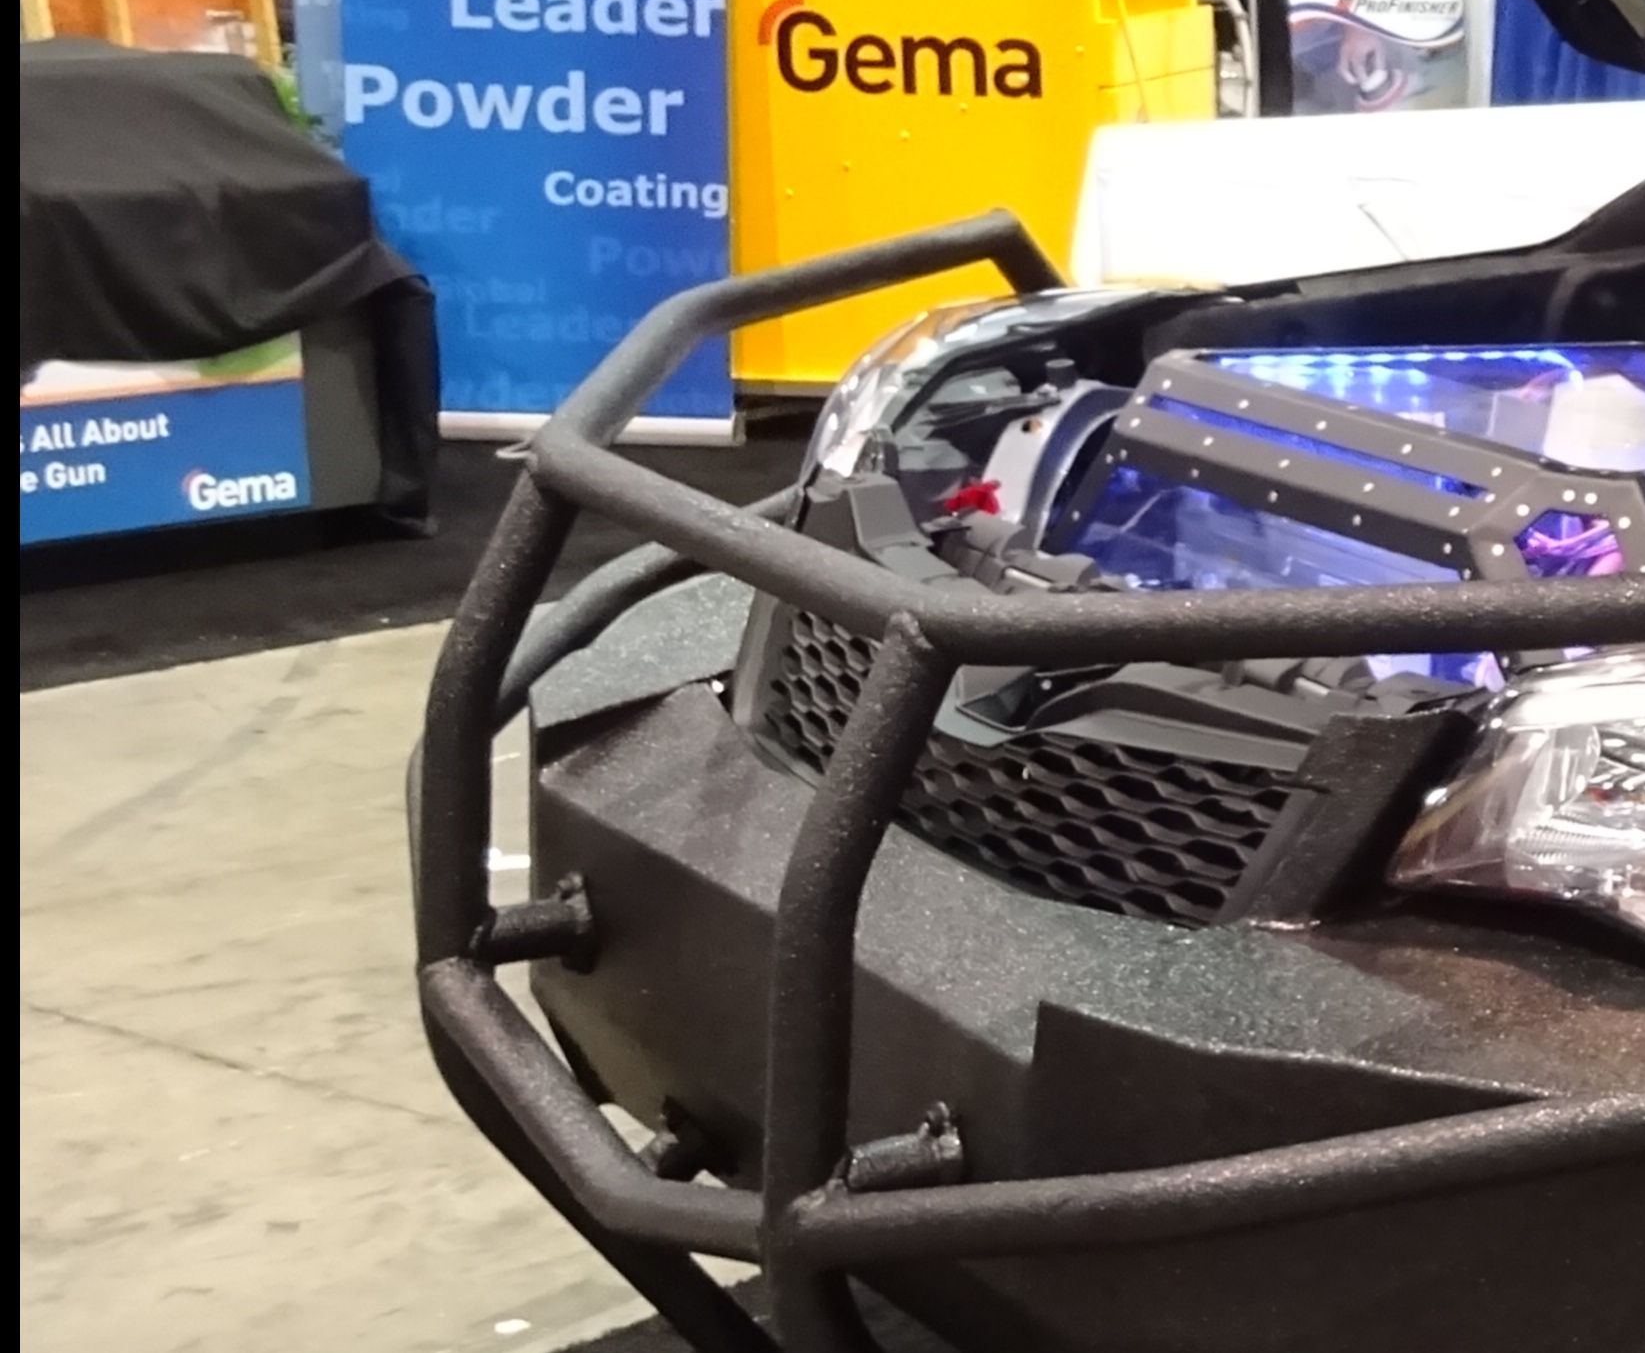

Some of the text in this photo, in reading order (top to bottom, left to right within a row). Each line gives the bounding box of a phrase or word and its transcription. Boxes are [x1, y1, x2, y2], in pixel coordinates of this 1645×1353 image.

[776, 9, 1042, 99] Gema
[345, 64, 684, 136] Powder
[543, 170, 729, 219] Coating
[464, 302, 640, 343] Leade
[30, 423, 76, 453] All
[81, 412, 170, 448] About
[45, 461, 107, 489] Gun
[189, 467, 296, 510] Gema
